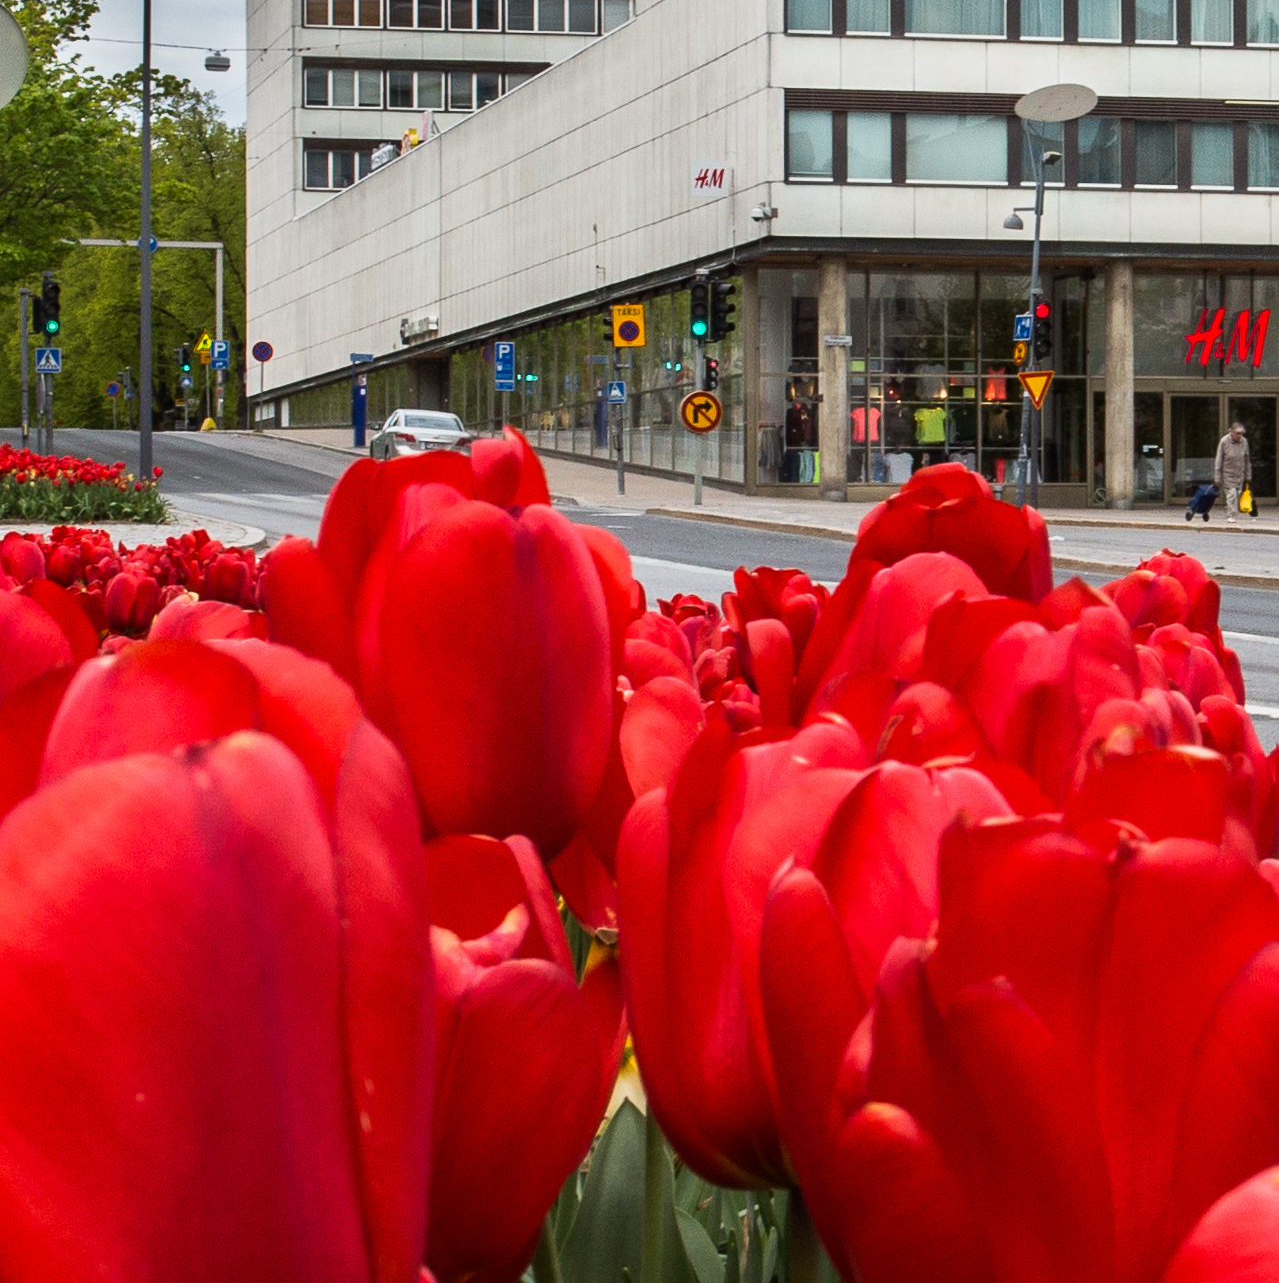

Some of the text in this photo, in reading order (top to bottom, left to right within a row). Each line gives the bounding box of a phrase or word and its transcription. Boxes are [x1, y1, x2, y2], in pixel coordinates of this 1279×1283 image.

[694, 168, 725, 189] H&M
[1185, 308, 1270, 368] H&M
[214, 342, 227, 358] P
[499, 345, 510, 359] P
